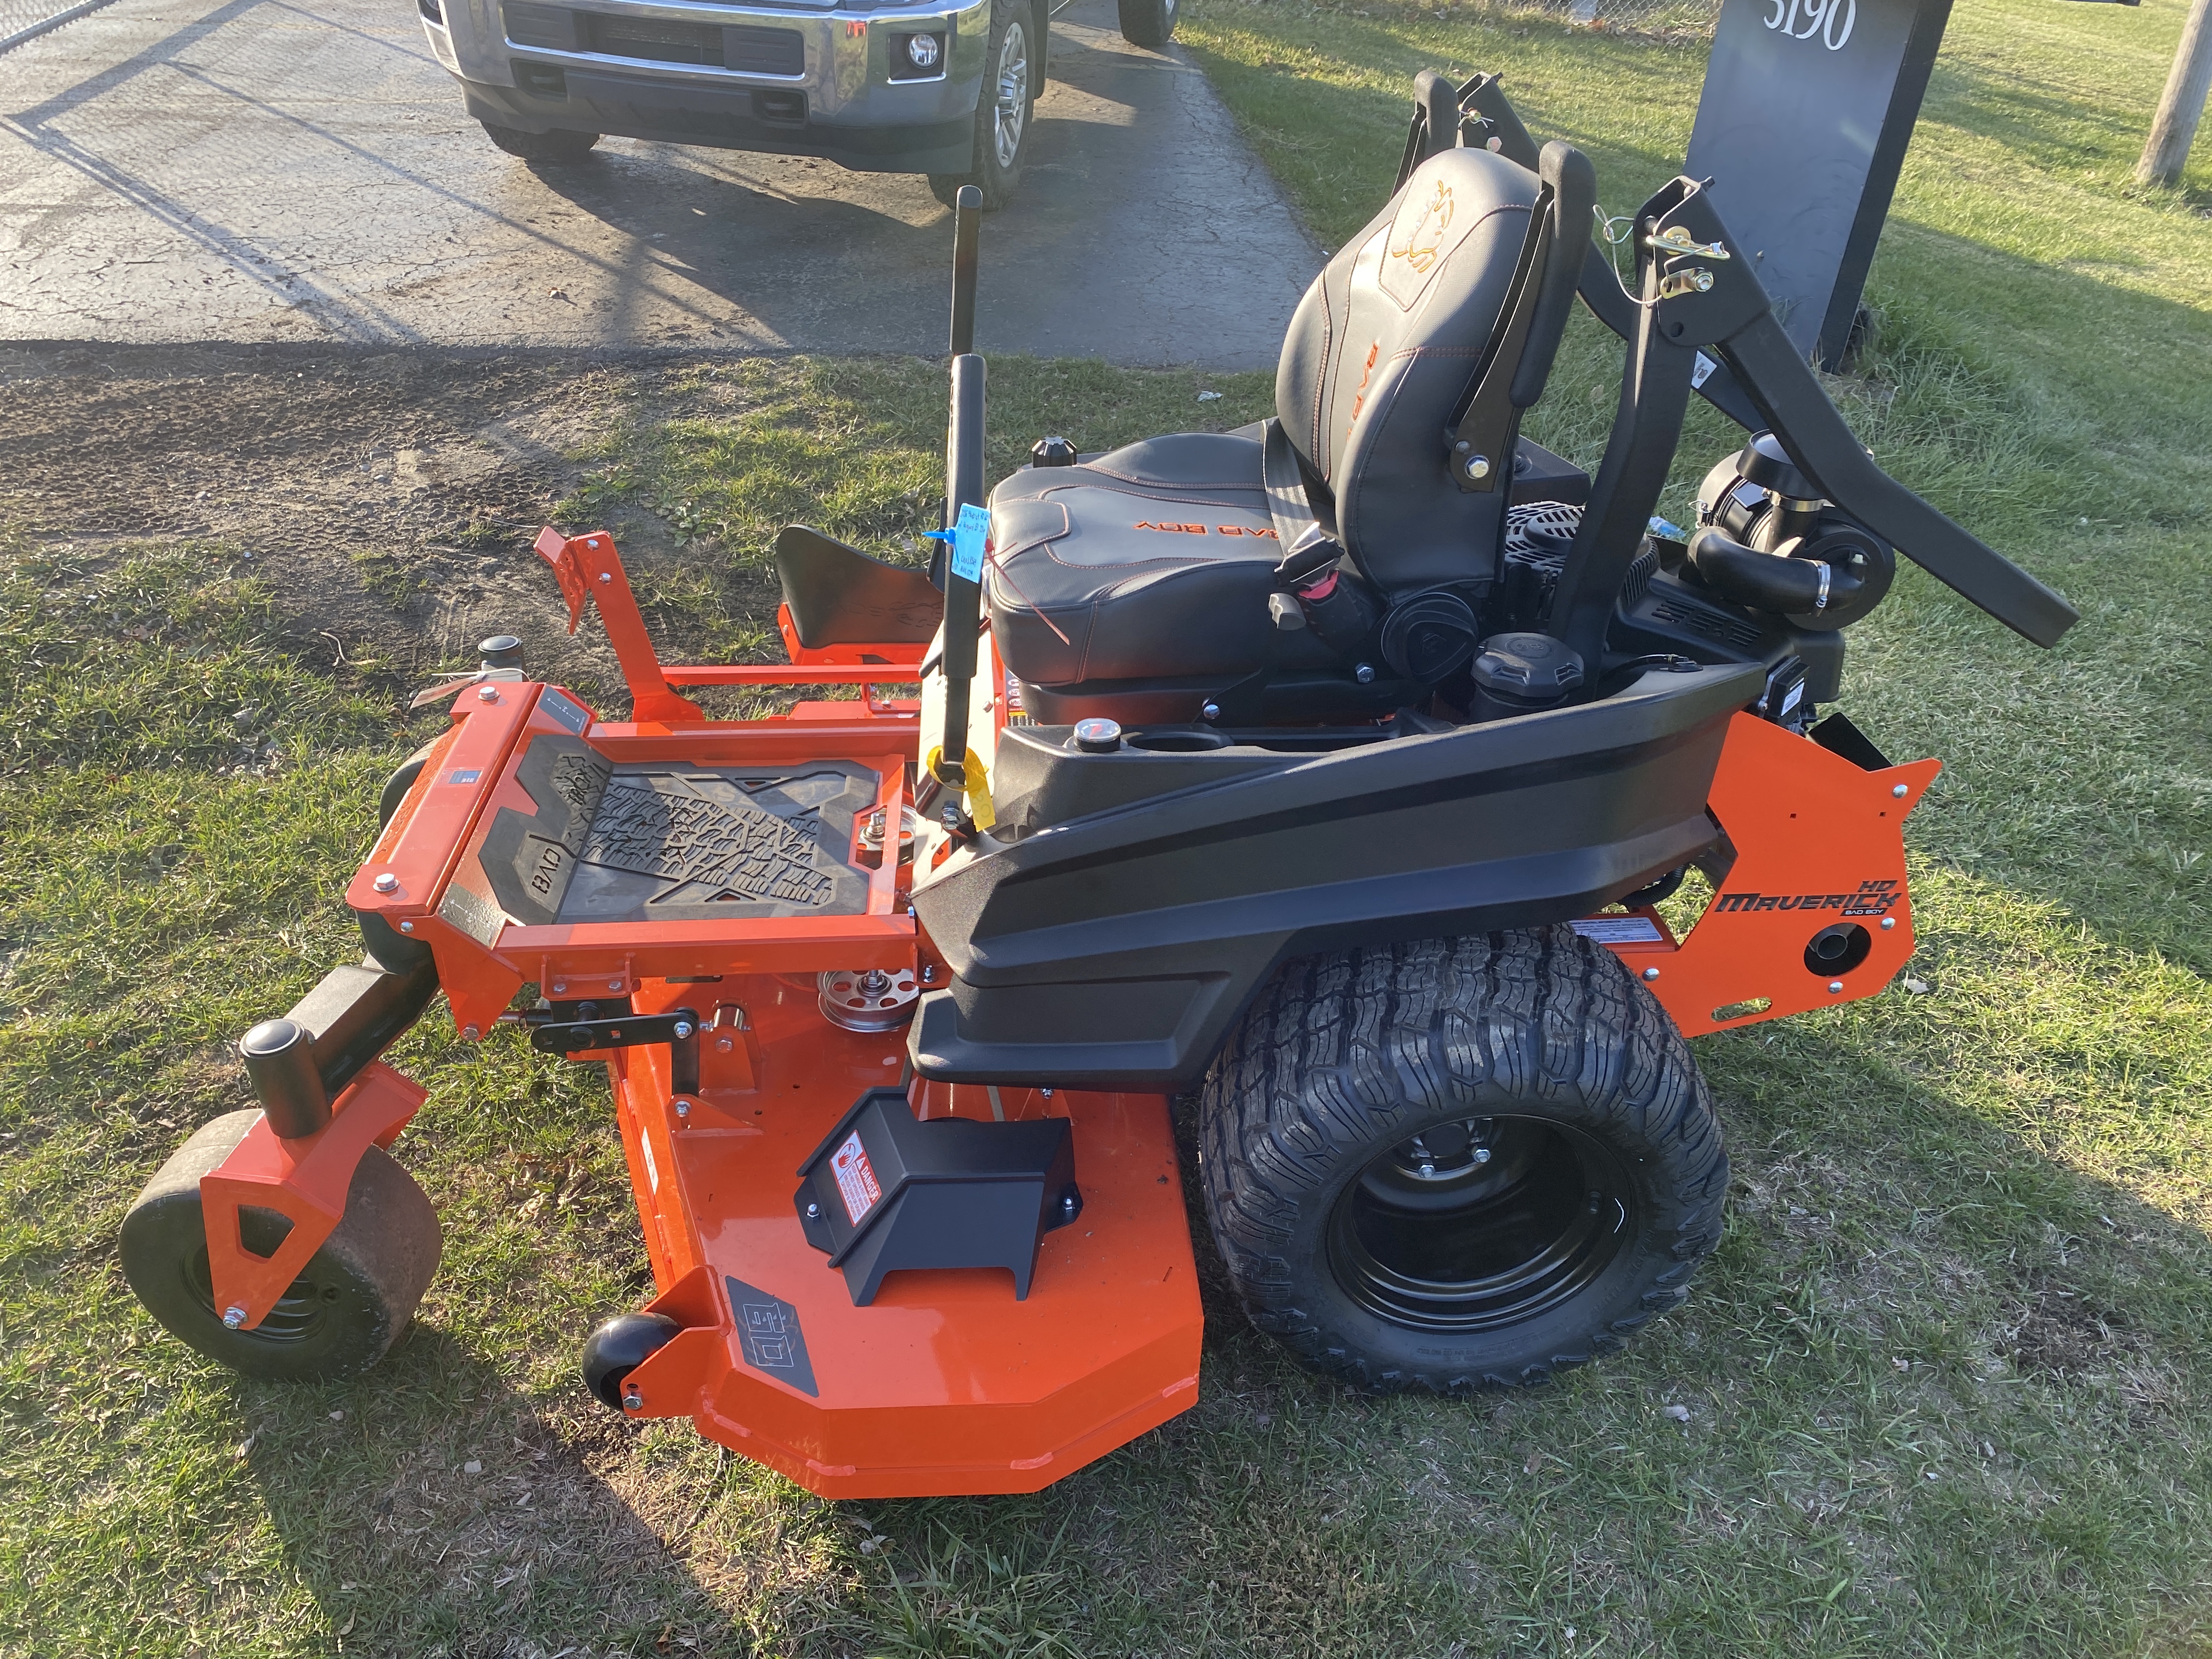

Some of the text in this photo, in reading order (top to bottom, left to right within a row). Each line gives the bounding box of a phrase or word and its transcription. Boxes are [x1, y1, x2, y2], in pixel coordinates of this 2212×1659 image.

[1133, 521, 1208, 535] BOY
[531, 847, 561, 894] BAD
[1857, 880, 1898, 892] HD
[861, 1166, 879, 1201] DANGER
